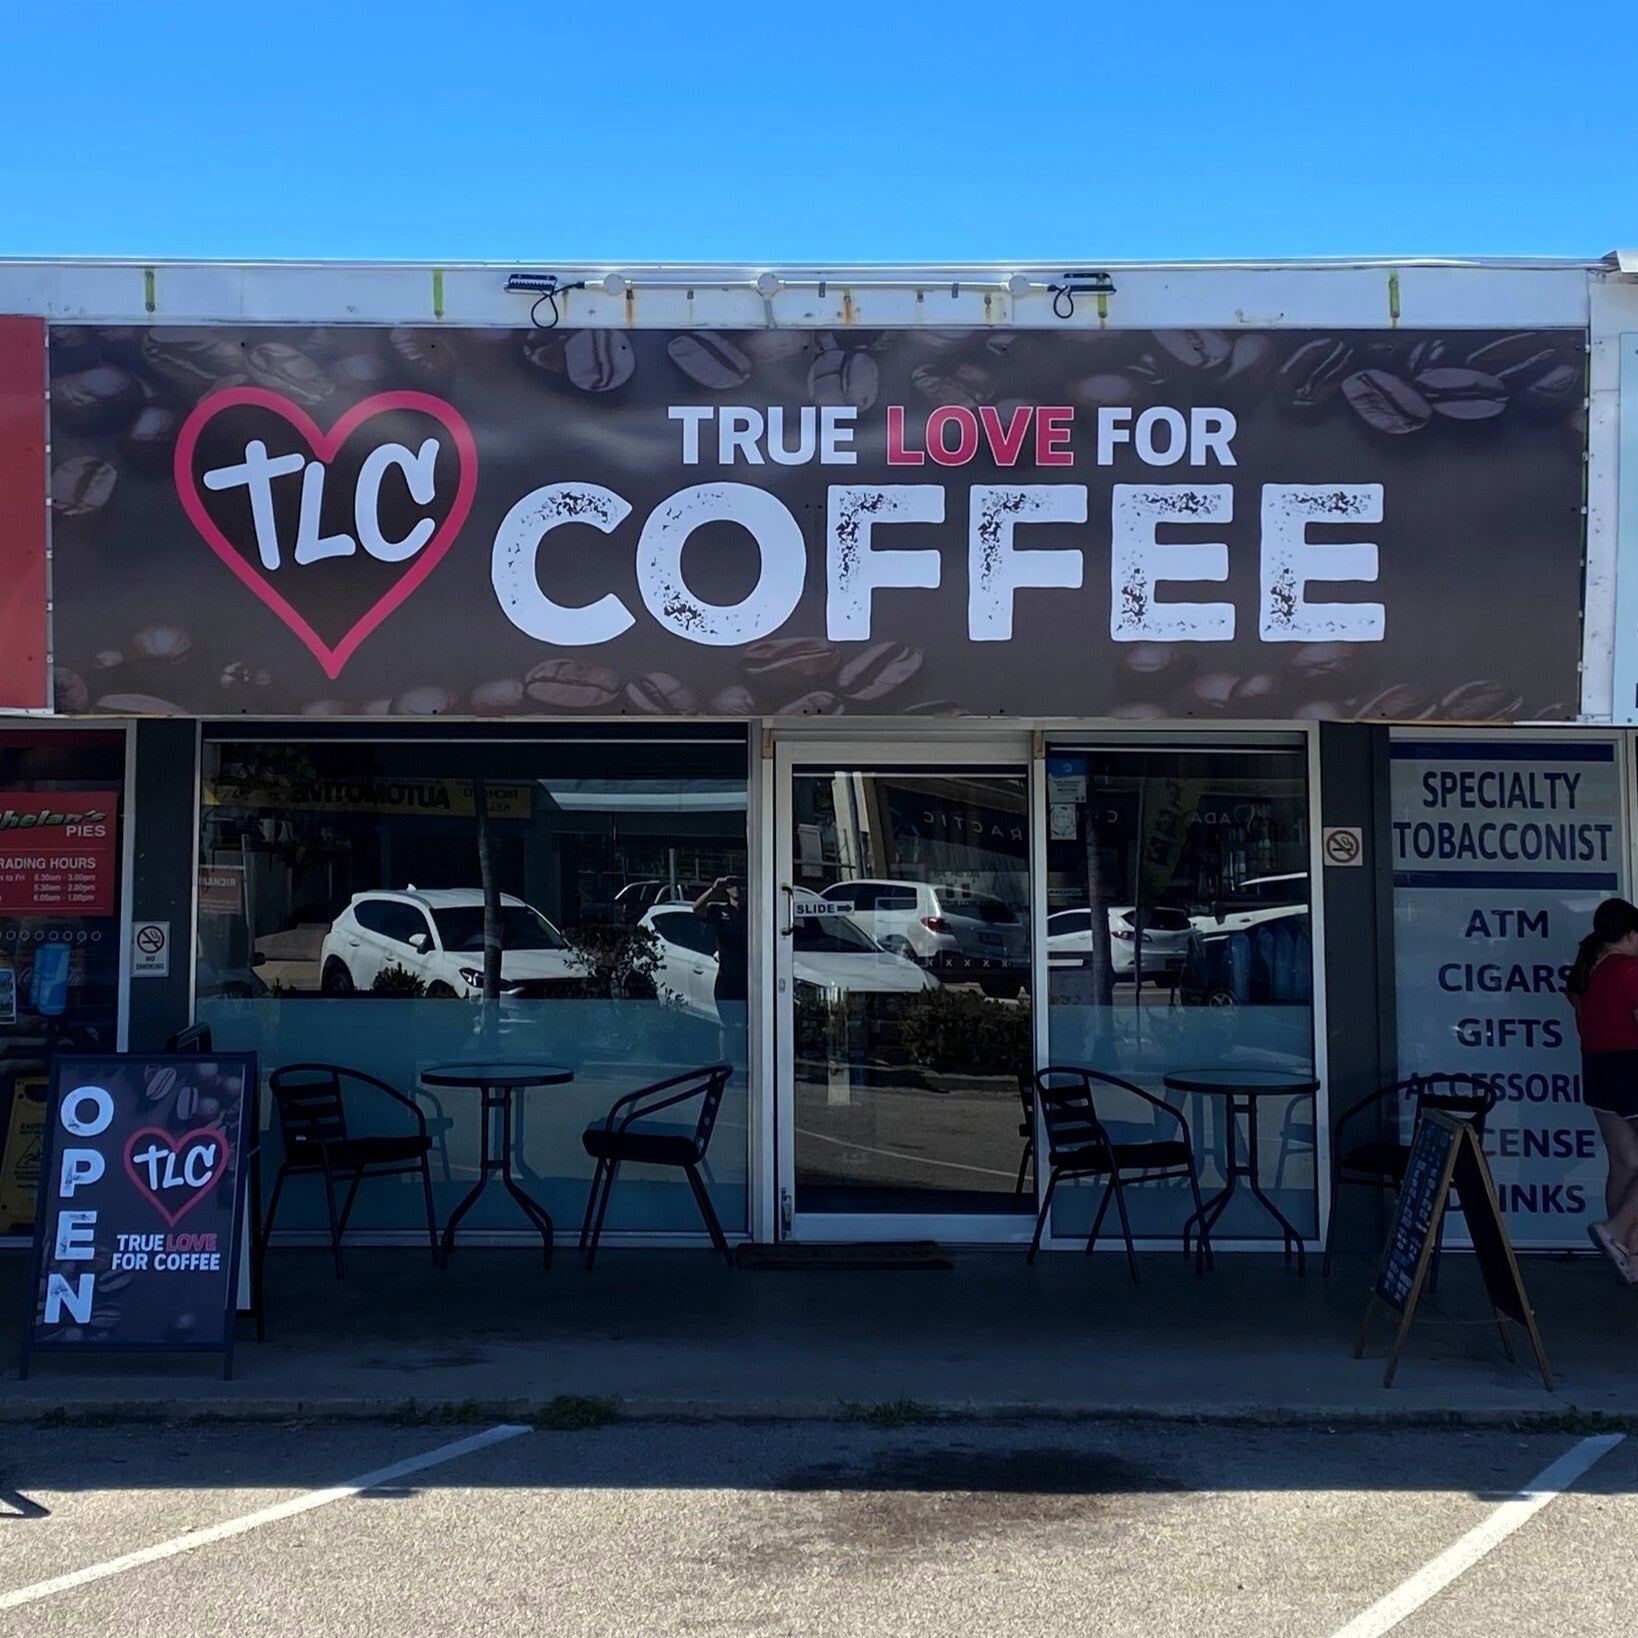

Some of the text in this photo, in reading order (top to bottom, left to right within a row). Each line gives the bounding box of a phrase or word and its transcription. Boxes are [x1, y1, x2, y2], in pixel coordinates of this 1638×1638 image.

[668, 405, 1238, 467] TRUE LOVE FOR
[203, 438, 440, 570] TLC
[491, 481, 1386, 646] COFFEE
[1422, 771, 1582, 810] SPECIALTY
[0, 810, 107, 831] helan's
[65, 825, 106, 837] PIES
[1393, 821, 1613, 862] TOBACCONIST
[0, 857, 96, 869] RADING HOURS
[796, 903, 836, 914] SLIDE
[1464, 909, 1549, 939] ATM
[145, 955, 155, 963] NO
[1438, 963, 1571, 993] CIGARS
[1456, 1018, 1563, 1048] GIFTS
[1483, 1128, 1596, 1158] CENSE
[133, 1143, 217, 1191] TLC
[44, 1086, 114, 1324] OPEN
[1446, 1184, 1586, 1214] INKS
[116, 1232, 218, 1252] TRUE LOVE
[112, 1252, 221, 1271] FOR COFFEE
